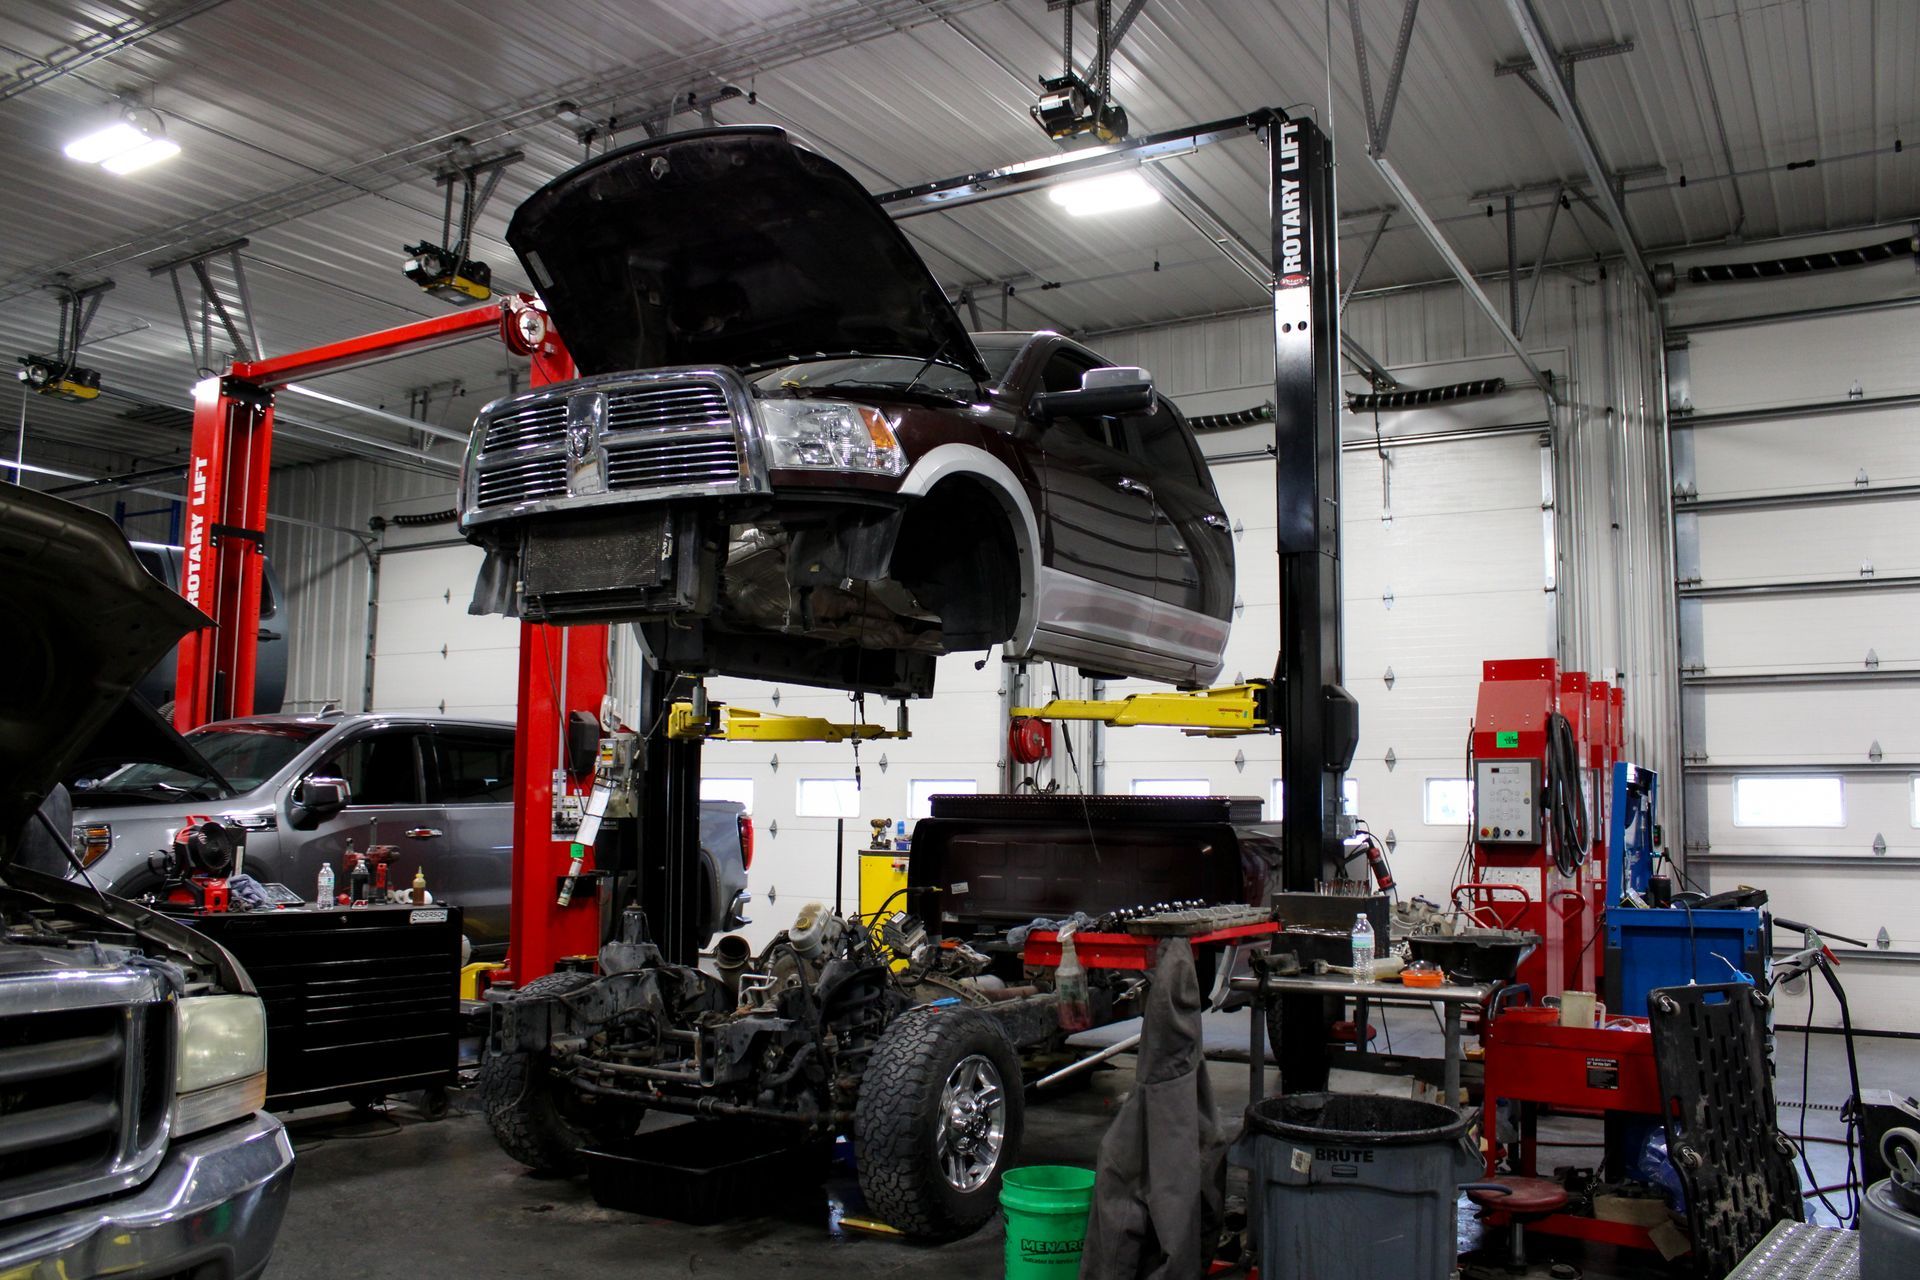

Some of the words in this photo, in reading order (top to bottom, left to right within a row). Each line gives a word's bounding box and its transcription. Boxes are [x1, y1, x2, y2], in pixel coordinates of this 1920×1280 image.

[1281, 122, 1299, 173] LIFT
[1281, 179, 1302, 274] ROTARY
[193, 457, 208, 506] LIFT
[187, 513, 204, 609] ROTARY
[1315, 1148, 1374, 1163] BRUTE
[1021, 1239, 1085, 1253] MENAR
